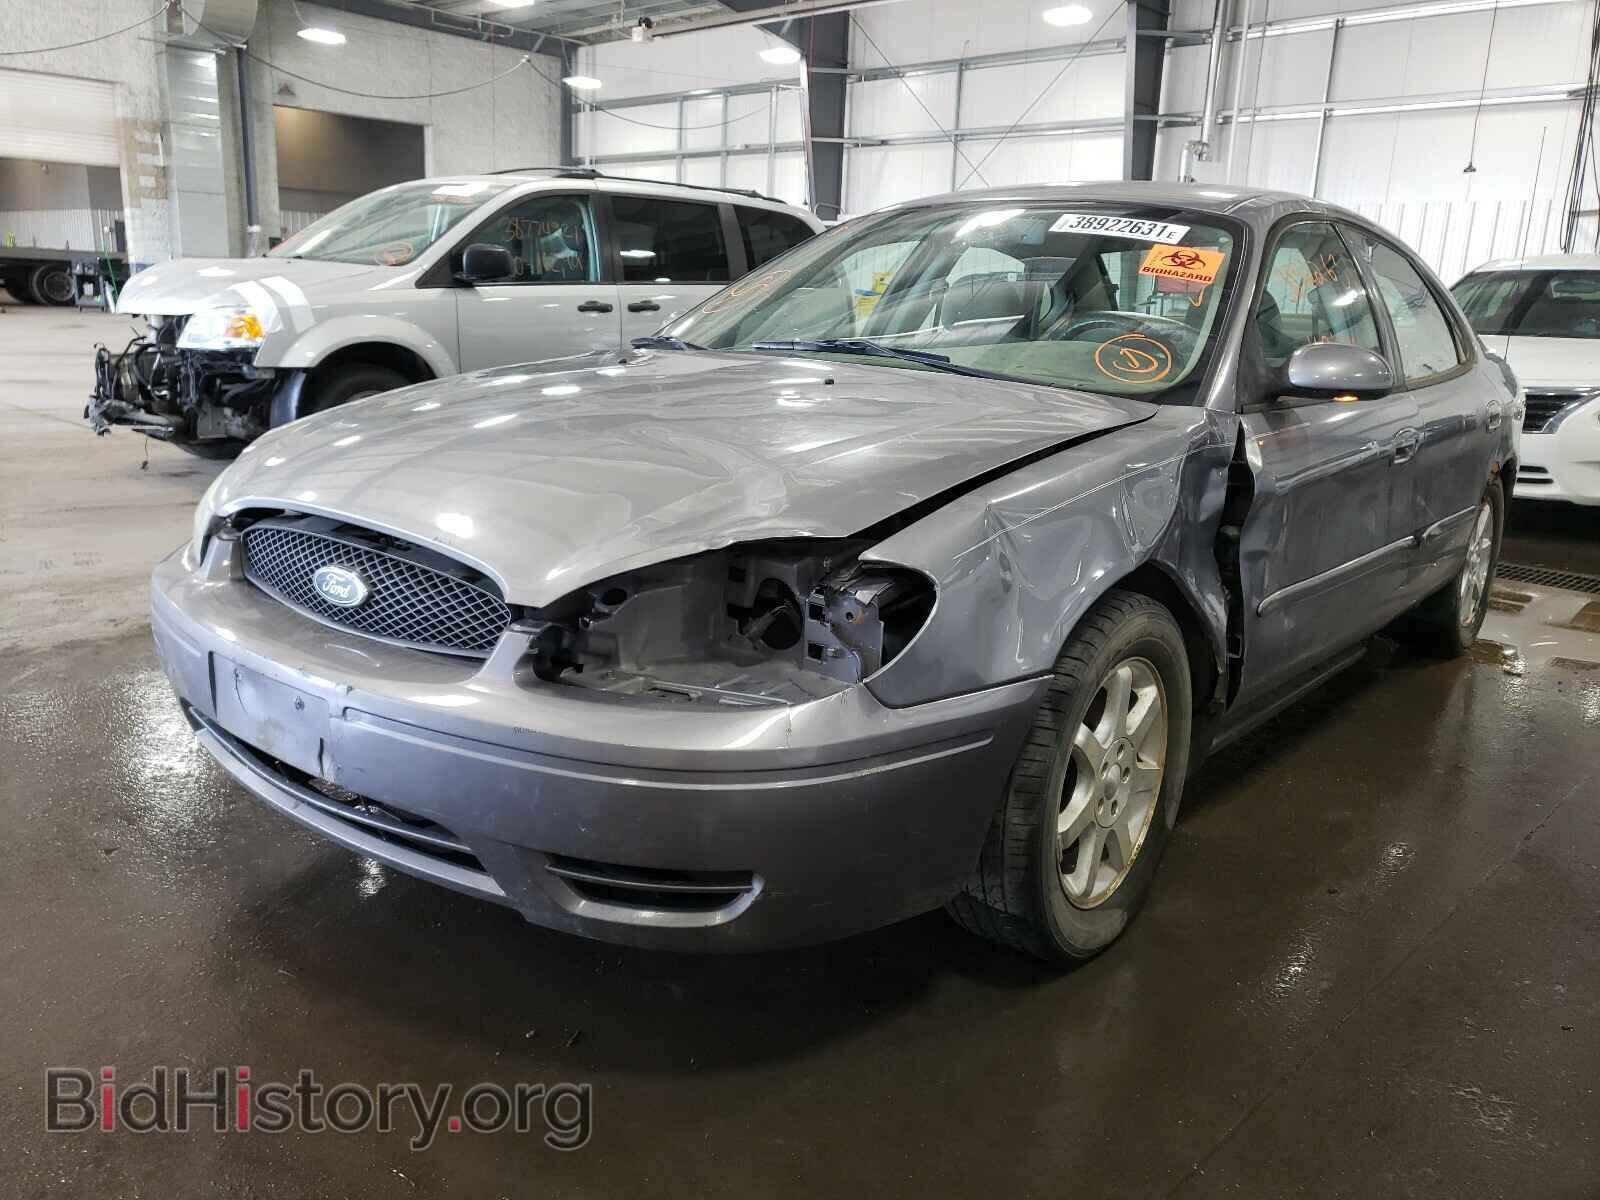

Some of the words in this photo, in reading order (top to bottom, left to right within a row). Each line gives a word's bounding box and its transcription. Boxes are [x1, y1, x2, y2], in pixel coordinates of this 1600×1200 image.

[1069, 215, 1169, 238] 38922631
[1141, 266, 1213, 283] BIOHAZARD
[322, 573, 353, 599] Ford
